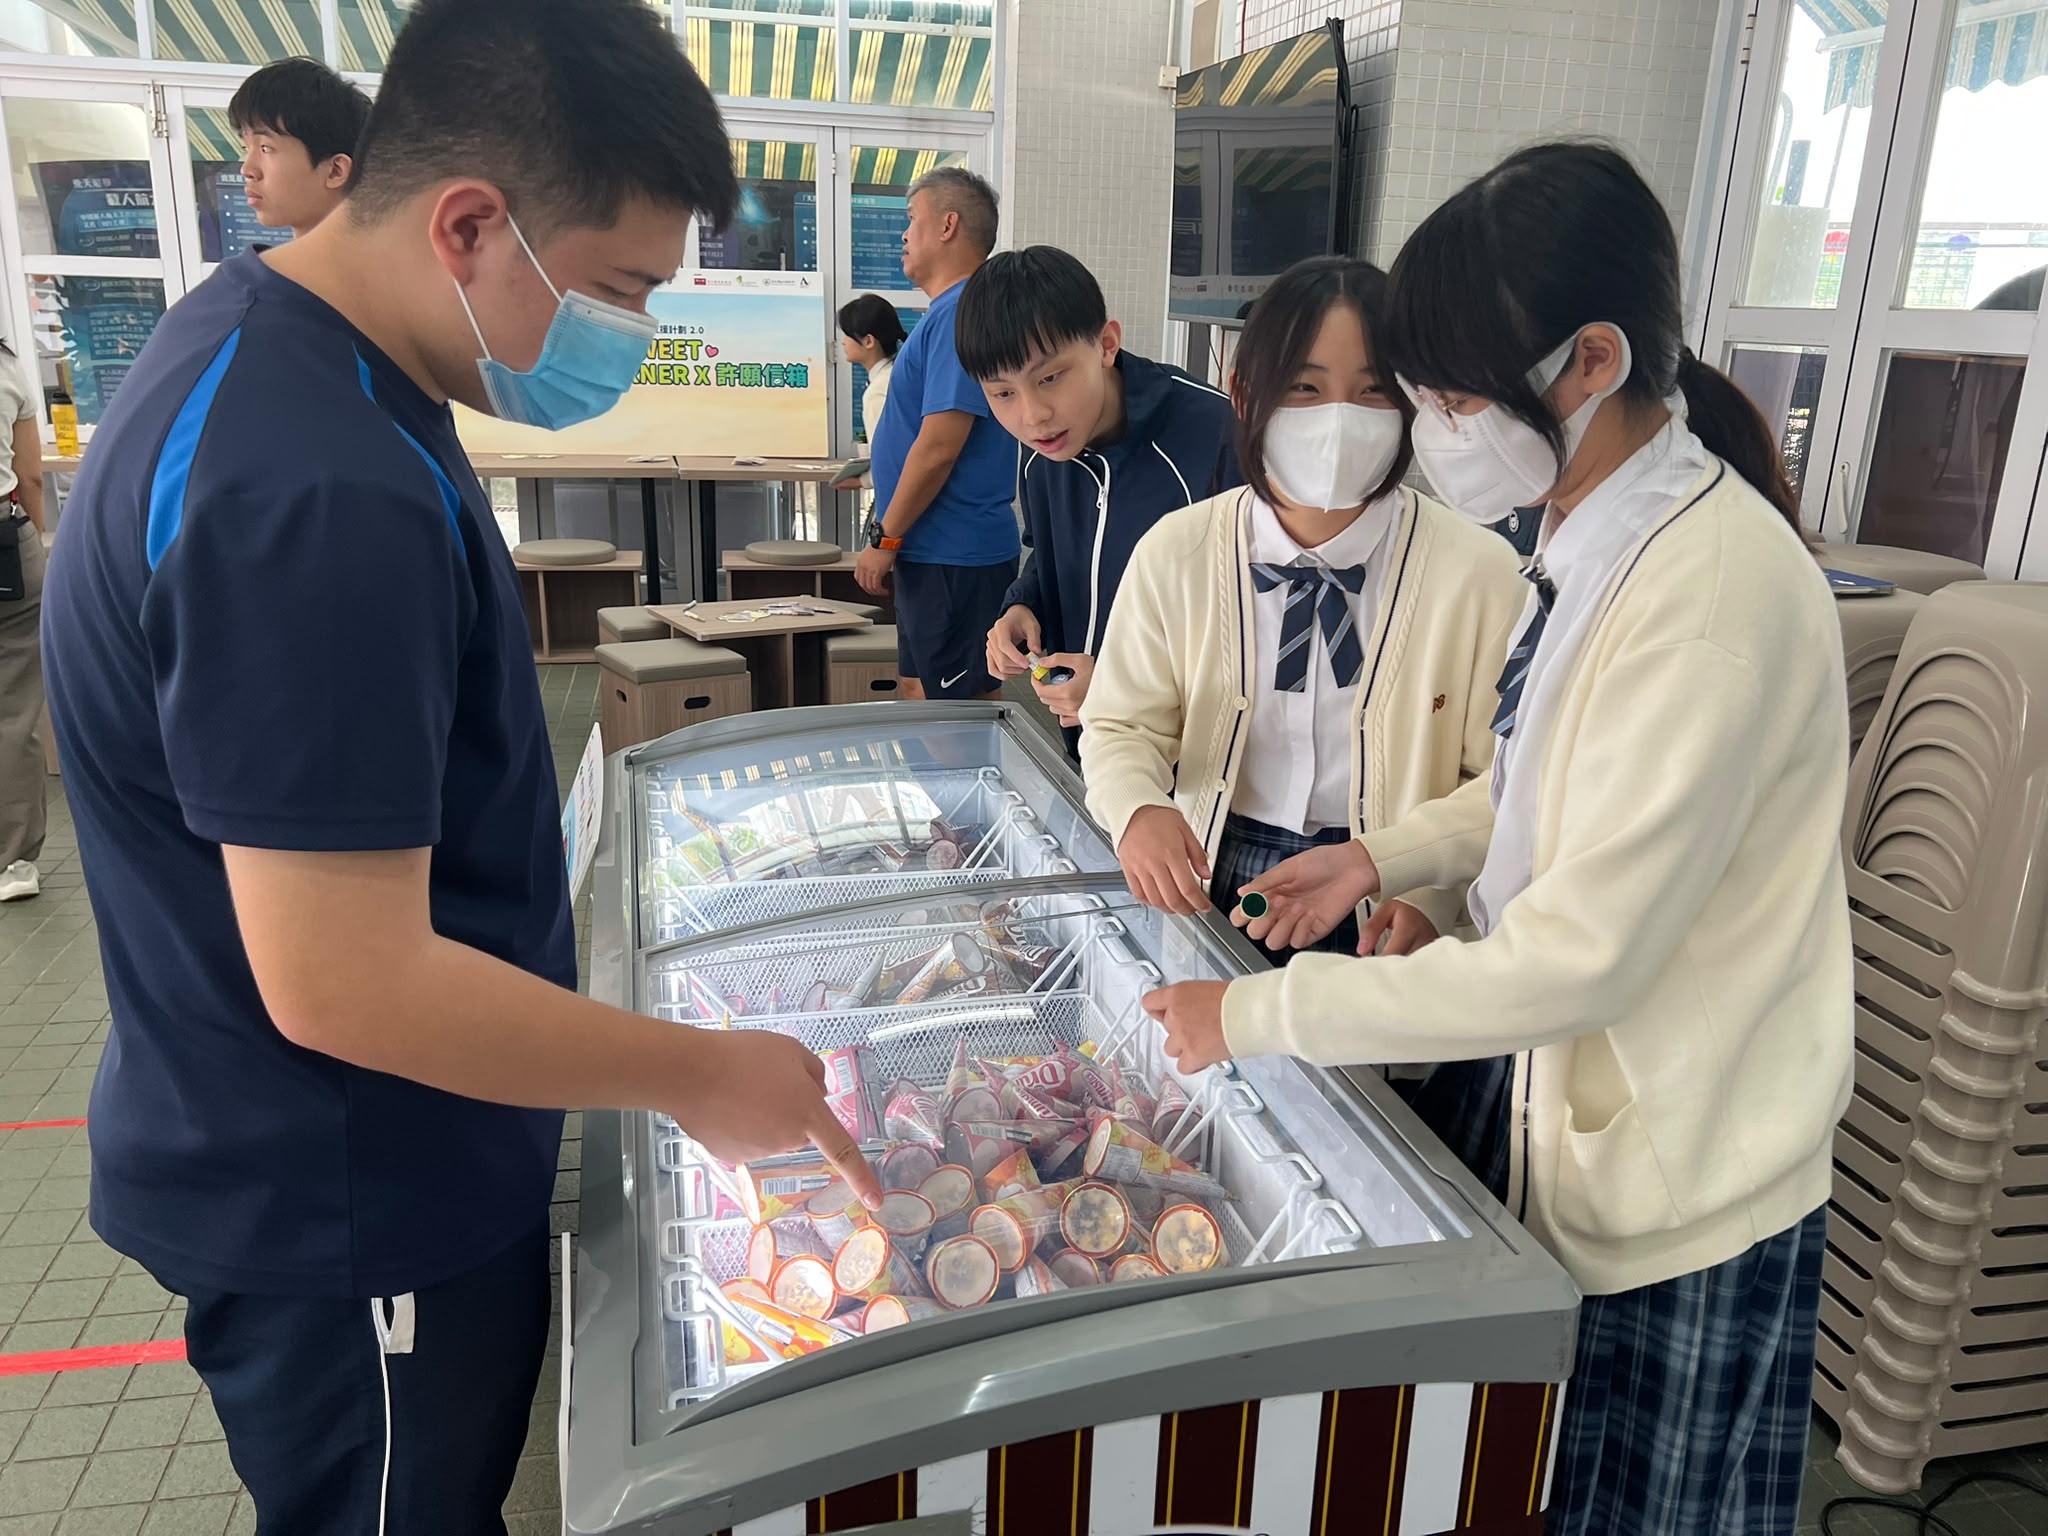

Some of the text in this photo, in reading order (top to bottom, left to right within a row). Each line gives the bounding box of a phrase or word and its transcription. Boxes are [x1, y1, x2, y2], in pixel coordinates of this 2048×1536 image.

[655, 324, 704, 334] 援計劃 2.0
[632, 362, 809, 388] NER X 許願信箱
